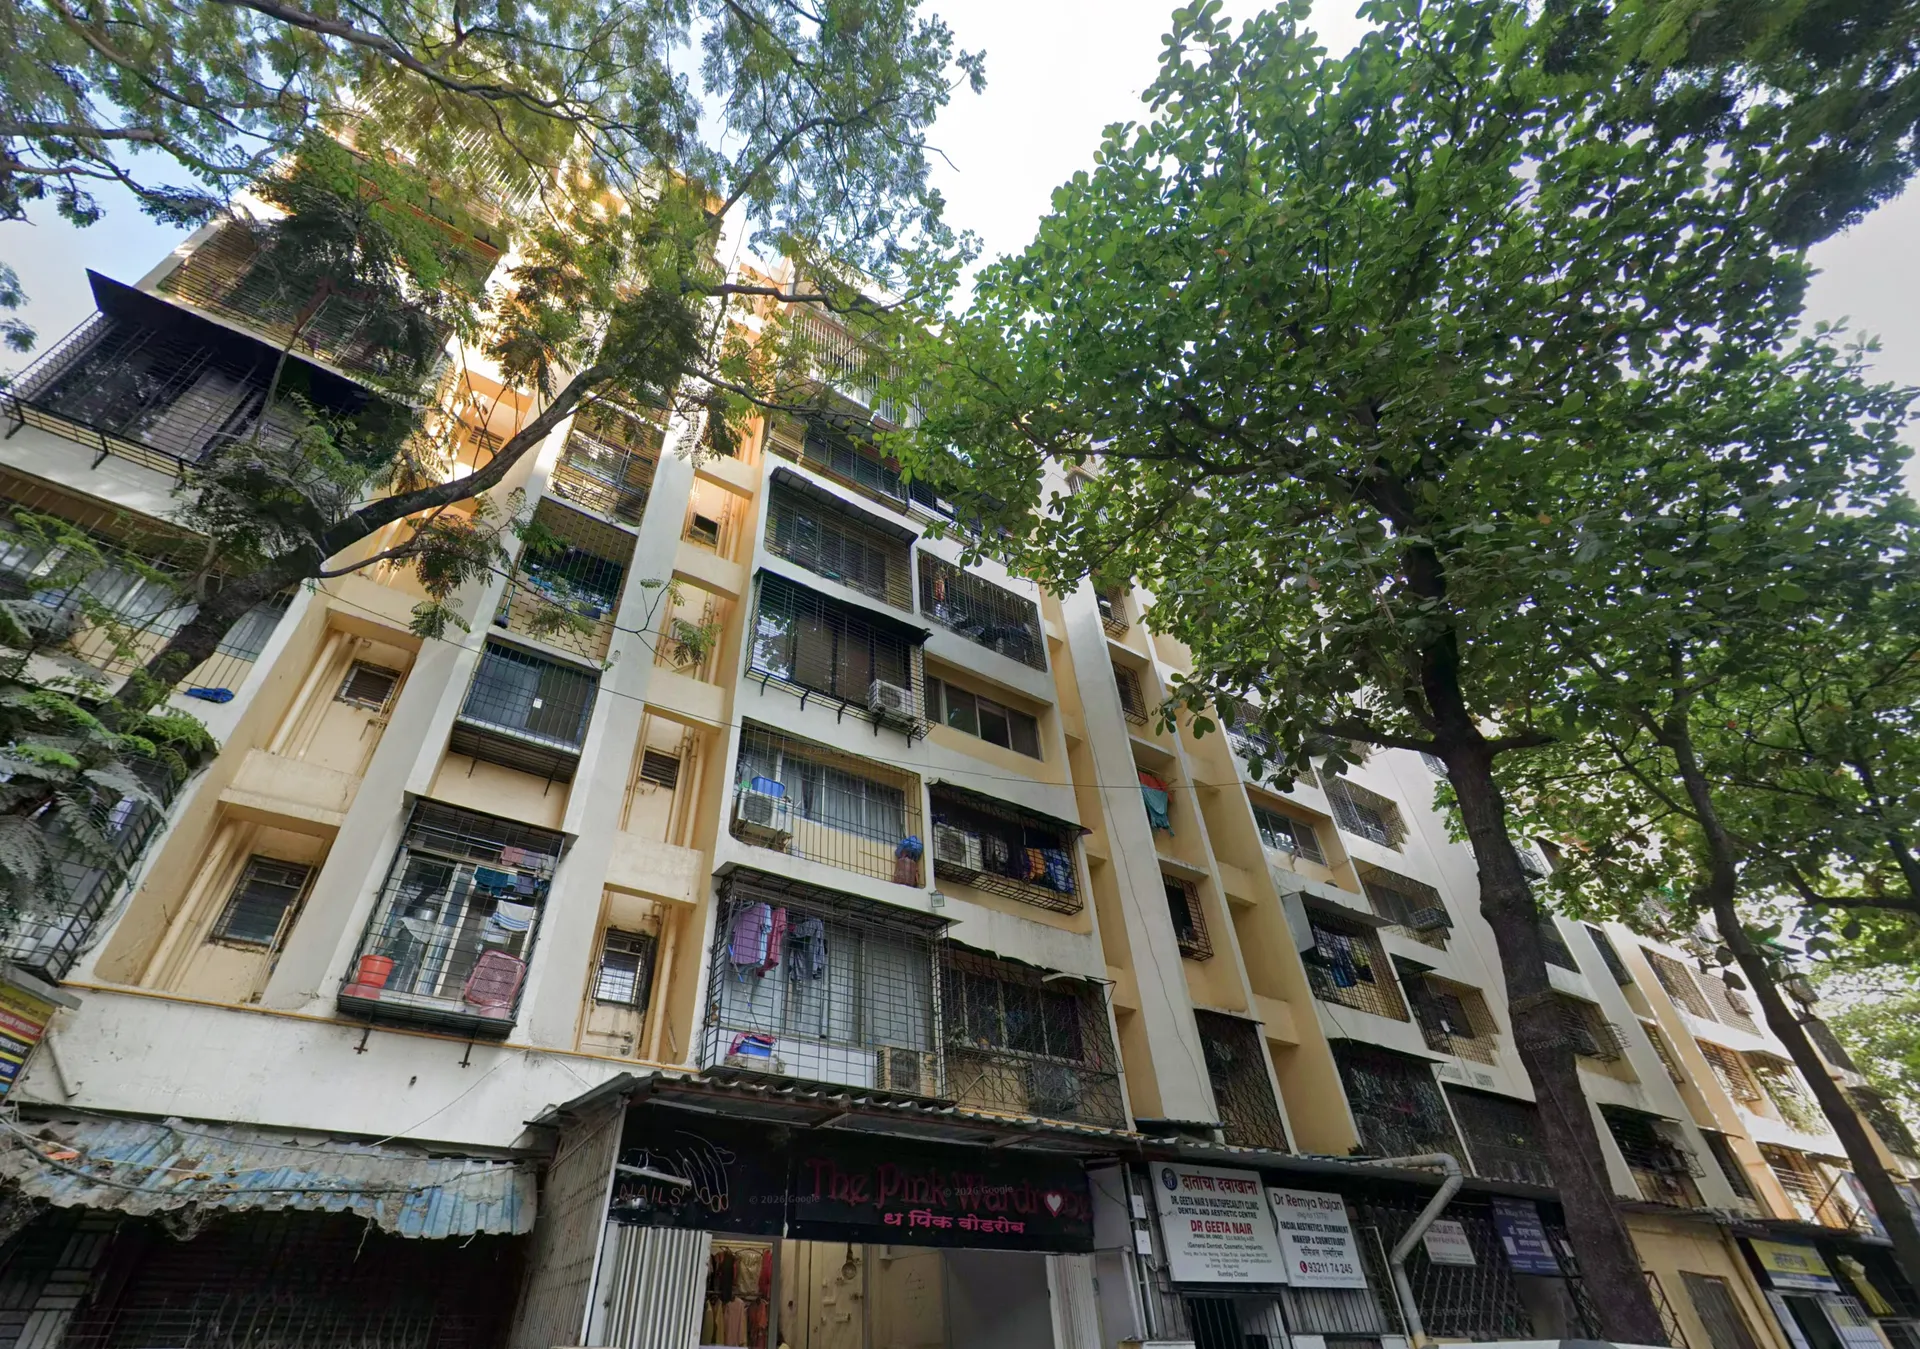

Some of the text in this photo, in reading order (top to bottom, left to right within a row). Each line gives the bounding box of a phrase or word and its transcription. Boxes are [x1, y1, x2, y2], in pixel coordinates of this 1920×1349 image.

[804, 1156, 870, 1208] The
[872, 1161, 948, 1210] Pink
[1180, 1172, 1258, 1196] दातांचा दवाखाना
[1273, 1193, 1342, 1212] Dr Remya Rajan
[908, 1208, 954, 1229] पिंक
[1178, 1207, 1198, 1215] DENTAL
[1200, 1208, 1210, 1216] AND
[1211, 1210, 1238, 1218] AESTHETIC
[1190, 1220, 1253, 1235] DR GEETA NAIR
[1308, 1262, 1353, 1274] 93211 74 245
